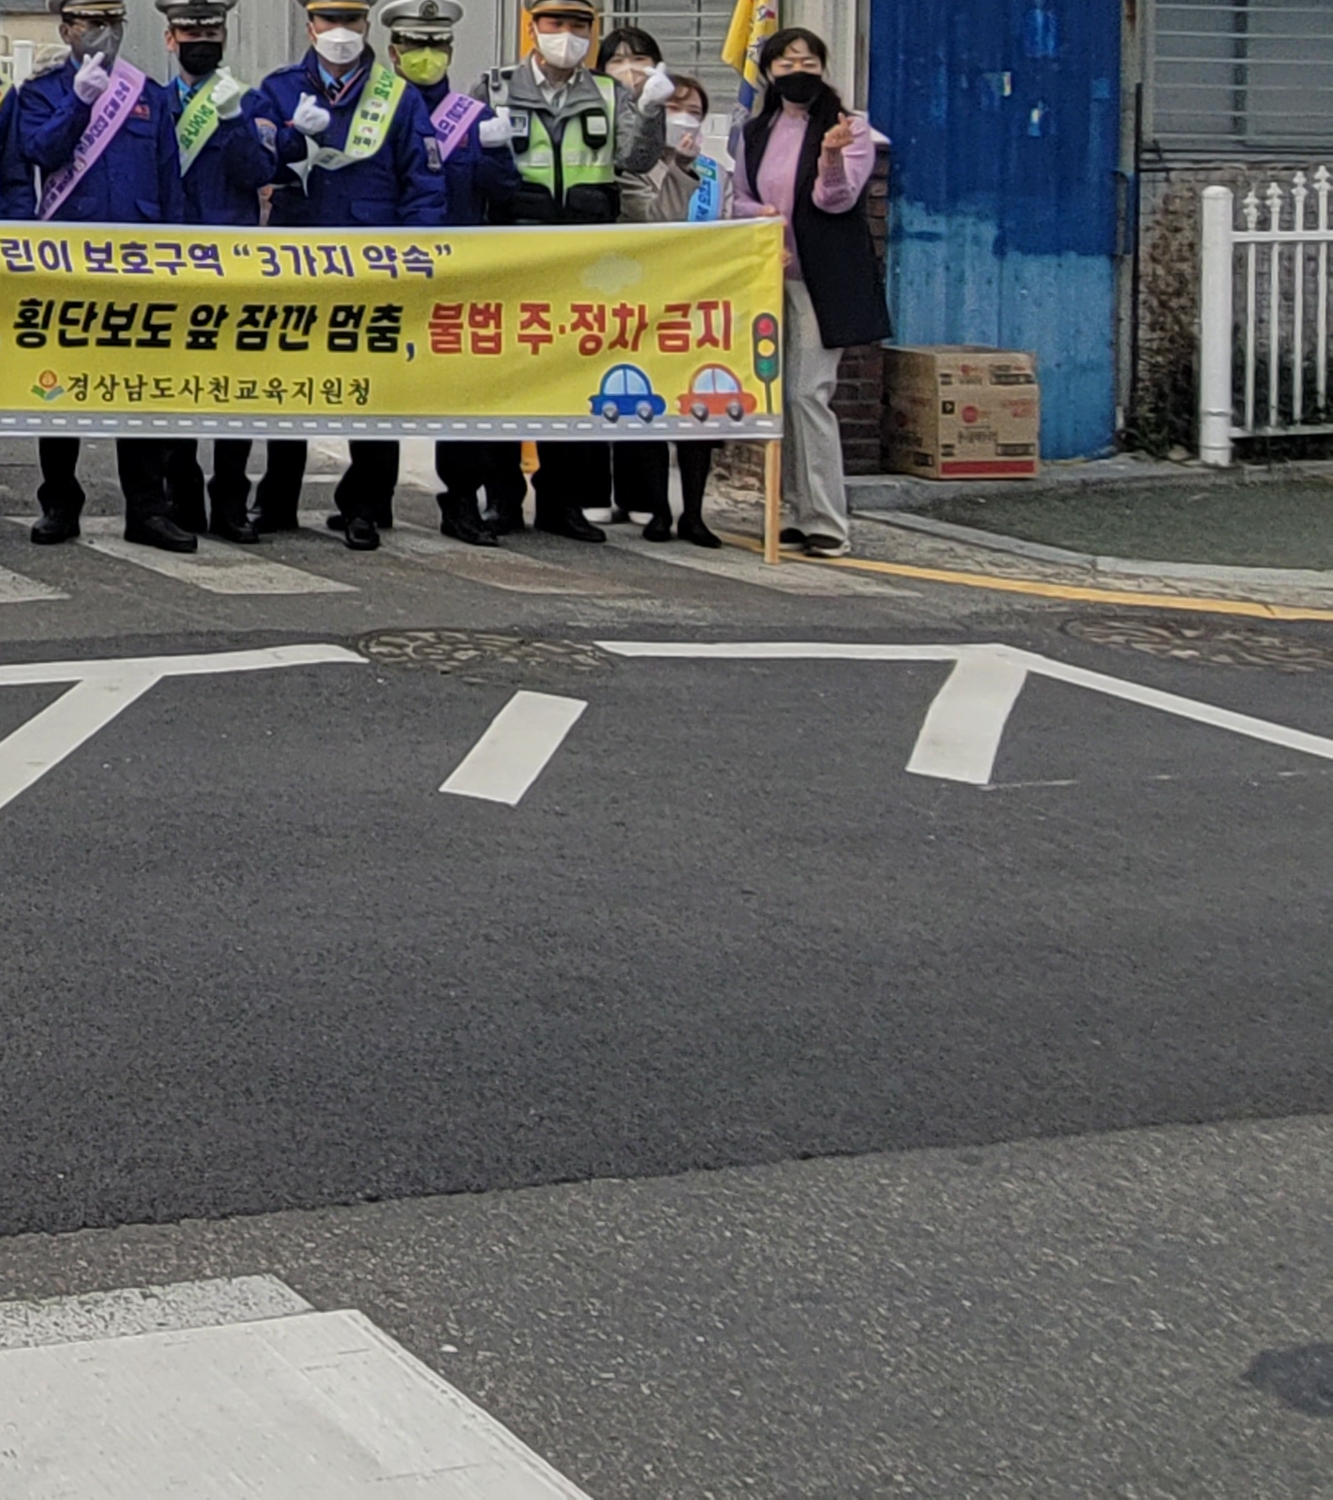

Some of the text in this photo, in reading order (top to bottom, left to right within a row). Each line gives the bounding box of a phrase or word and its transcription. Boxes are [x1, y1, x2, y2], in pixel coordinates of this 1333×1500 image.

[85, 242, 222, 275] 보호구역
[13, 298, 178, 348] 횡단보도
[186, 304, 229, 350] 앞
[236, 305, 318, 351] 잠깐
[328, 303, 414, 361] 멈춤,
[428, 302, 501, 354] 불법
[656, 301, 732, 352] 금지
[67, 372, 371, 406] 경상남도사천교육지원청
